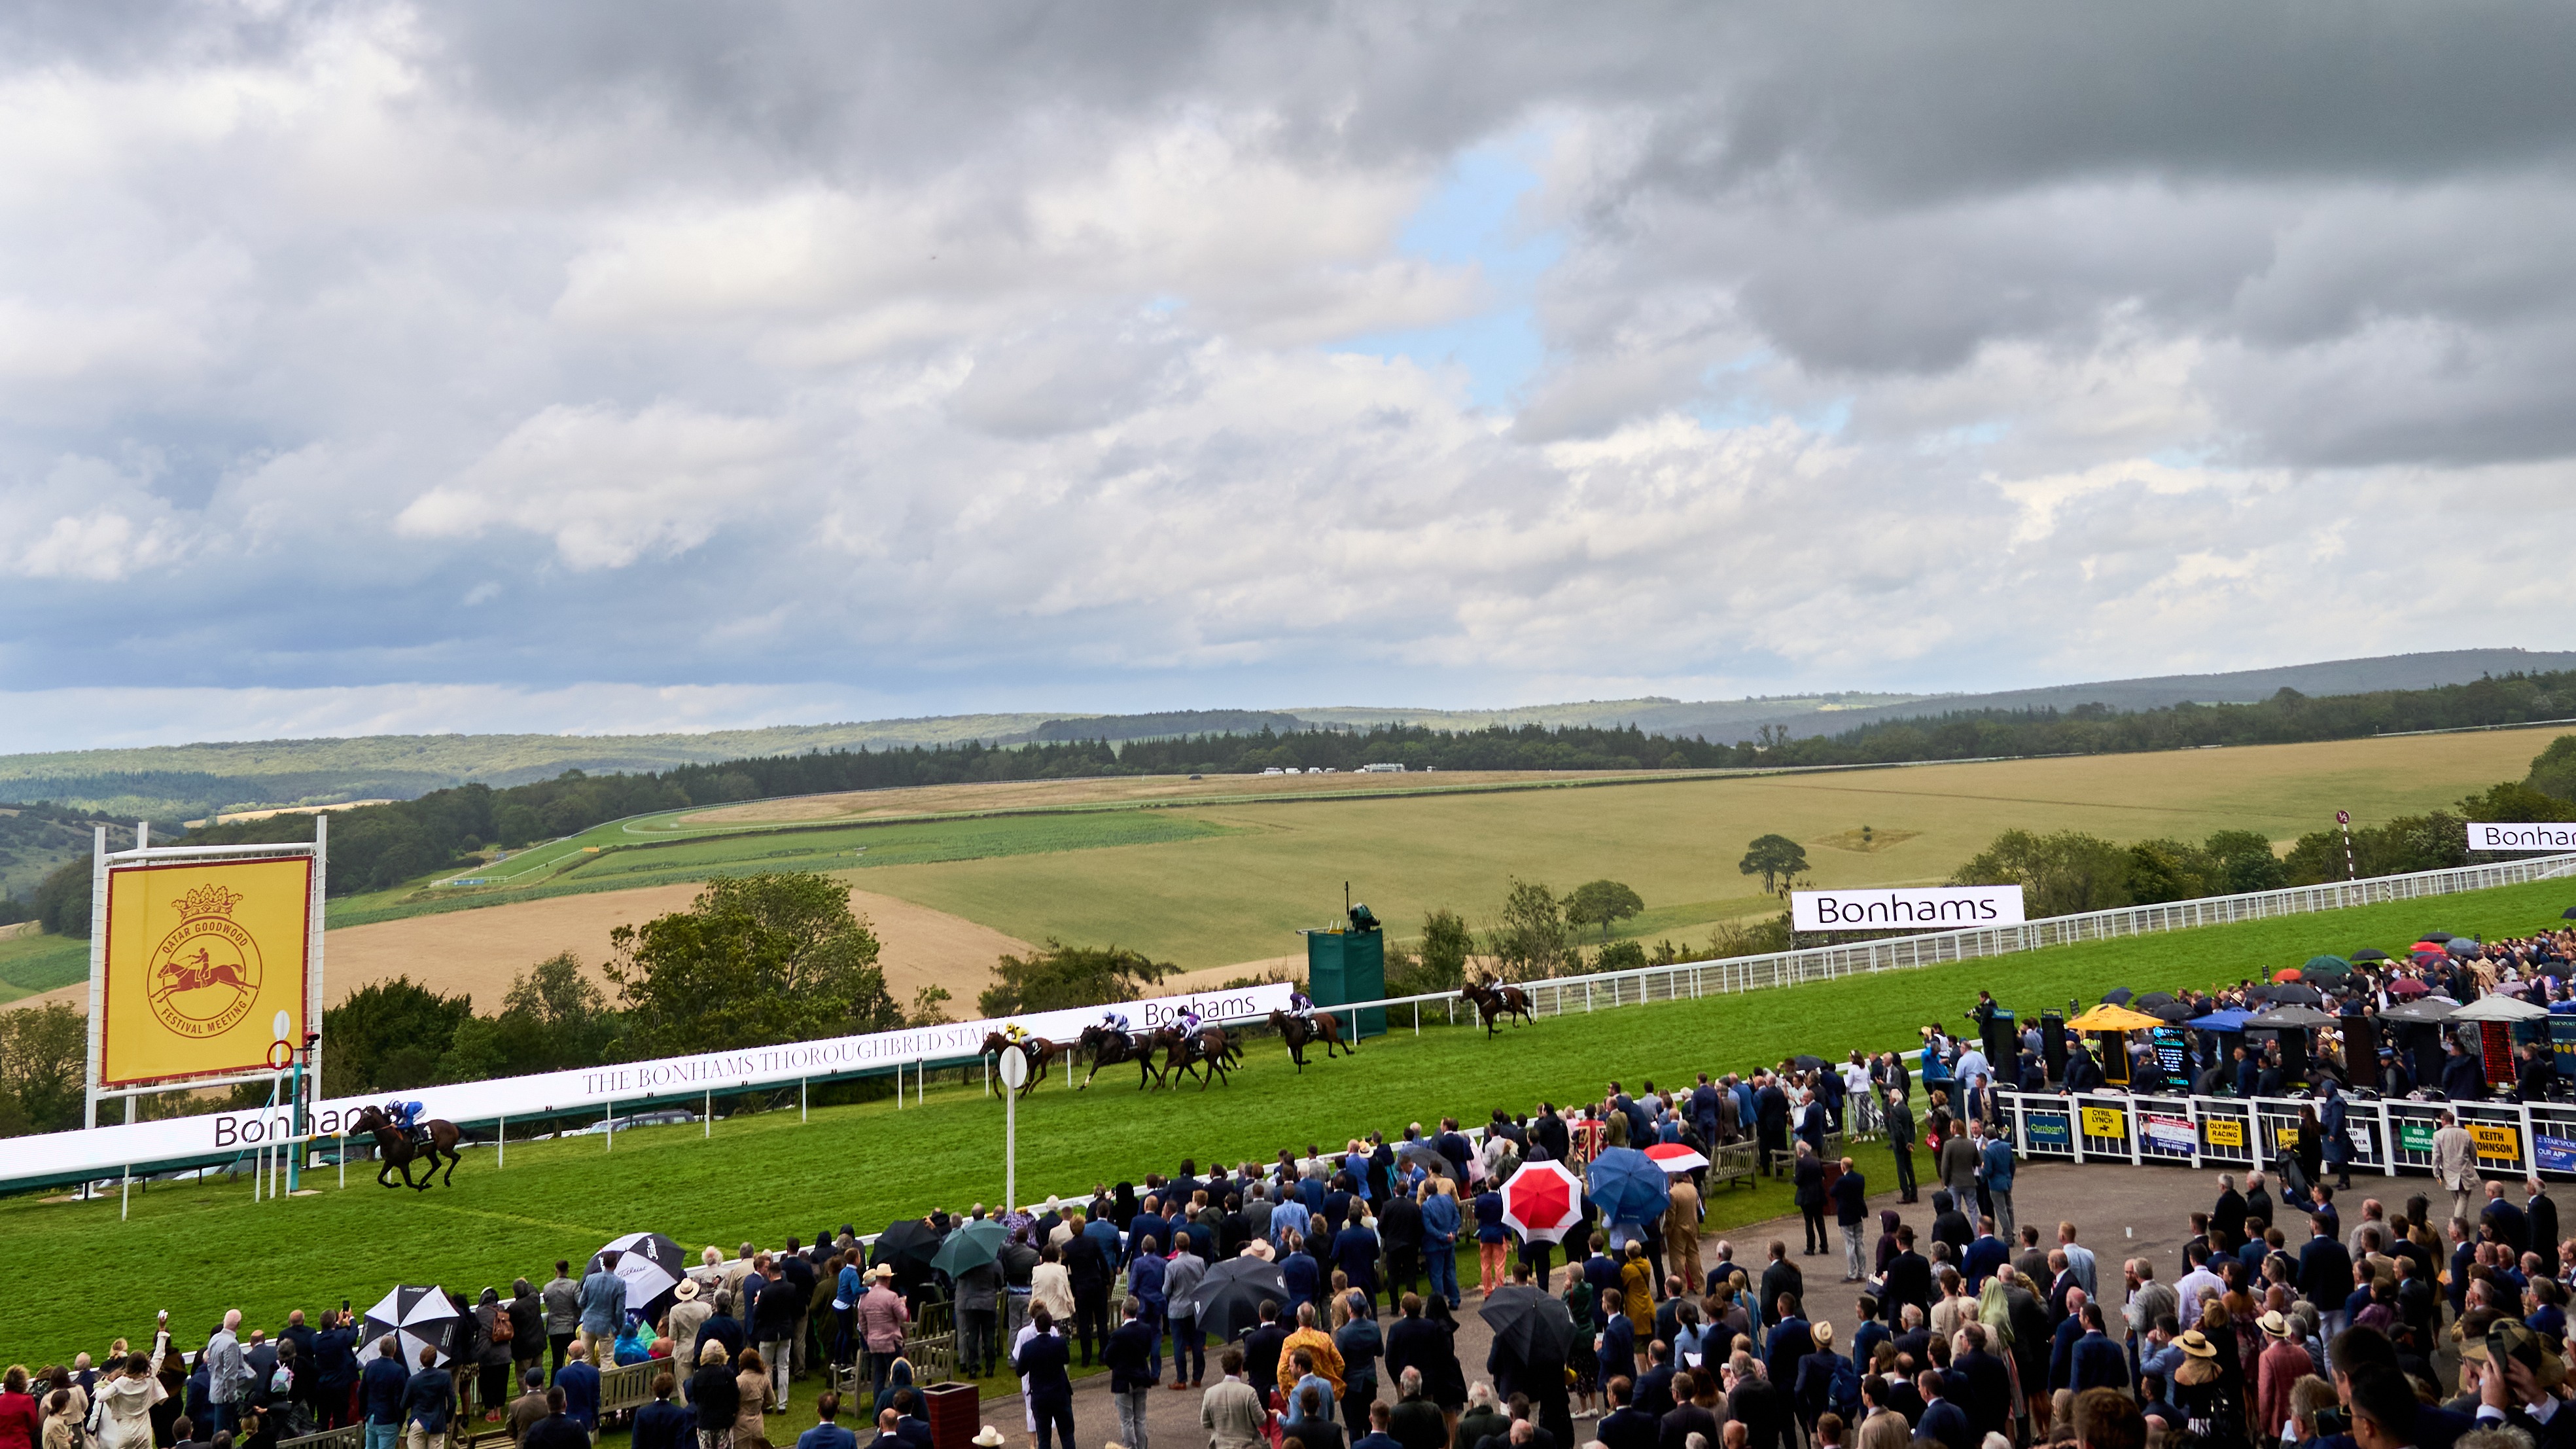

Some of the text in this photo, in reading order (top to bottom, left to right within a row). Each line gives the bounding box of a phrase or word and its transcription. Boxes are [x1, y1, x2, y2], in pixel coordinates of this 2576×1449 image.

[2485, 826, 2576, 846] Bonha
[1818, 893, 1998, 923] Bonhams
[162, 921, 248, 954] QATAR GOODWOOD
[161, 1001, 247, 1034] FESTIVAL MEETING
[582, 1024, 1004, 1095] THE BONHAMS THOROUGHBRED STAKE
[423, 1125, 432, 1139] 1
[2030, 1123, 2065, 1134] Currigan's
[2210, 1122, 2239, 1131] OLYMPIC
[2412, 1128, 2426, 1136] SID
[2479, 1131, 2505, 1142] KEITH
[2475, 1141, 2513, 1154] OHNSON
[618, 1265, 648, 1277] Titleist
